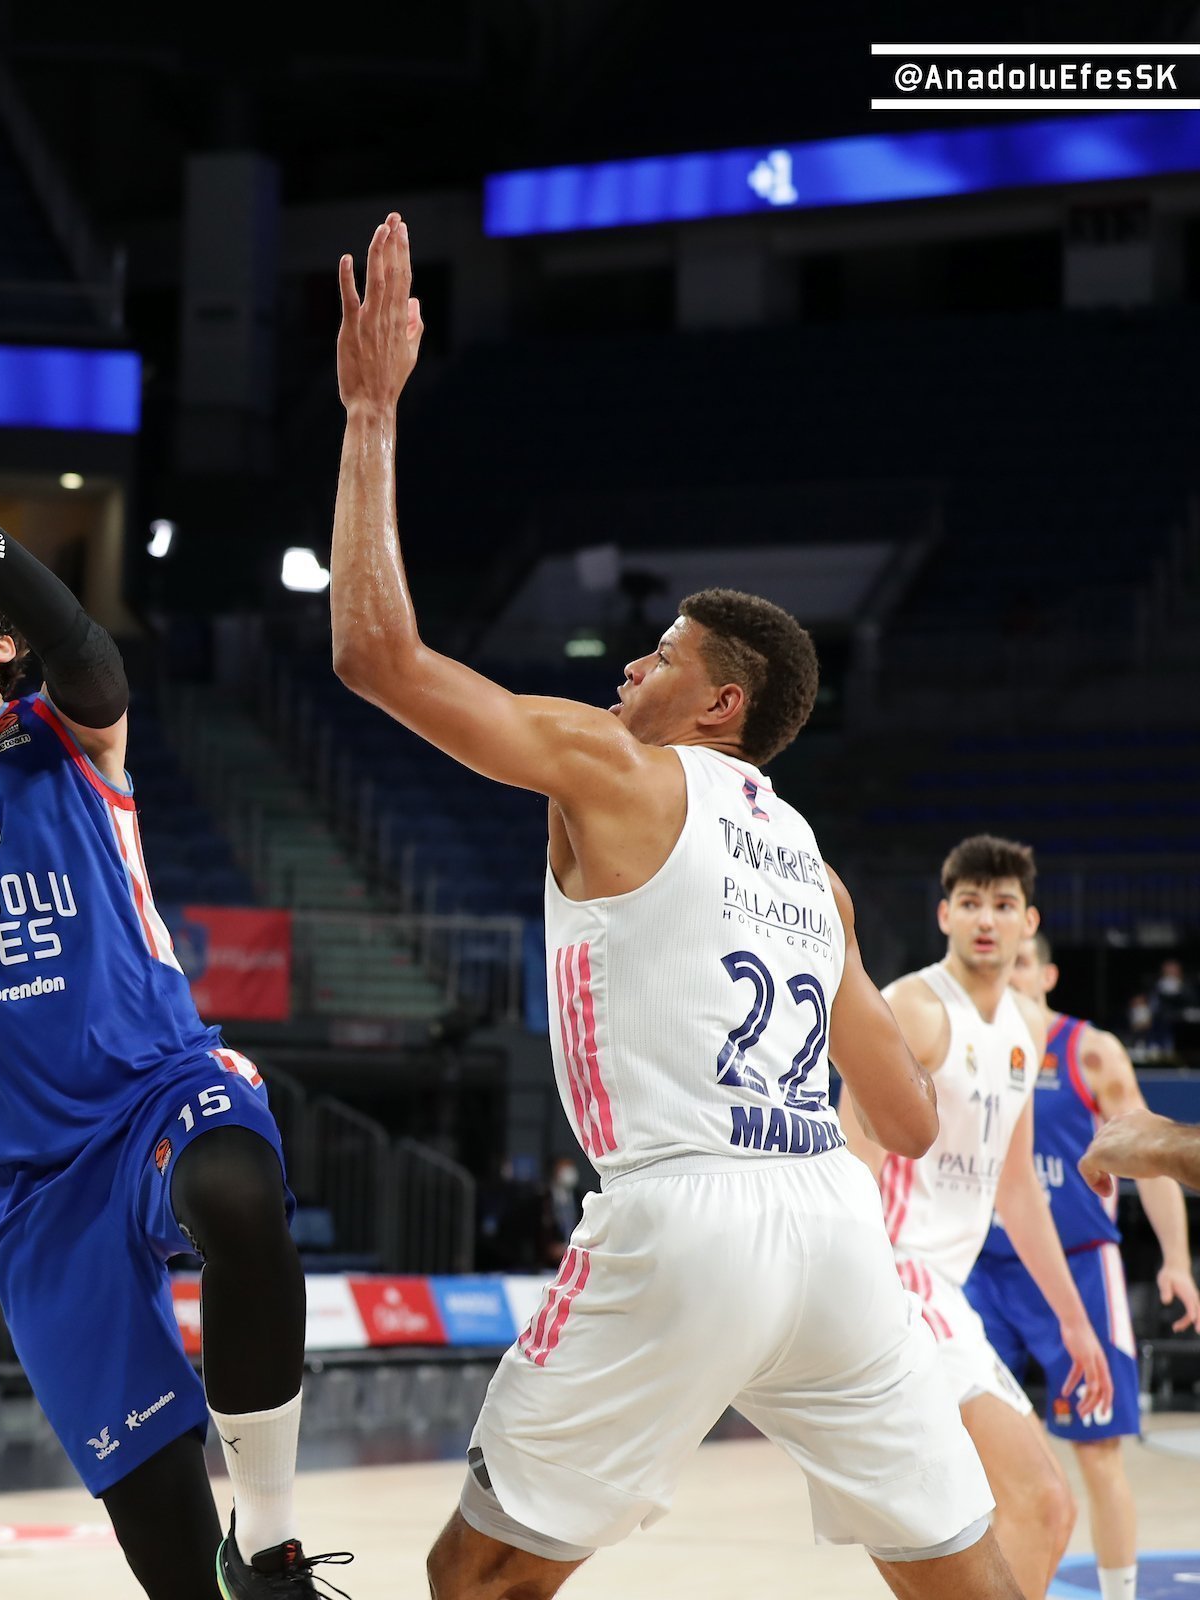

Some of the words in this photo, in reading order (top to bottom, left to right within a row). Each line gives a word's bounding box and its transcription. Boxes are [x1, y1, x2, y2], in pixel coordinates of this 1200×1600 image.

[718, 817, 825, 893] TAVARES
[723, 876, 832, 944] PALLADIUM
[717, 950, 828, 1112] 22
[177, 1084, 232, 1133] 15
[138, 1390, 177, 1422] corendon
